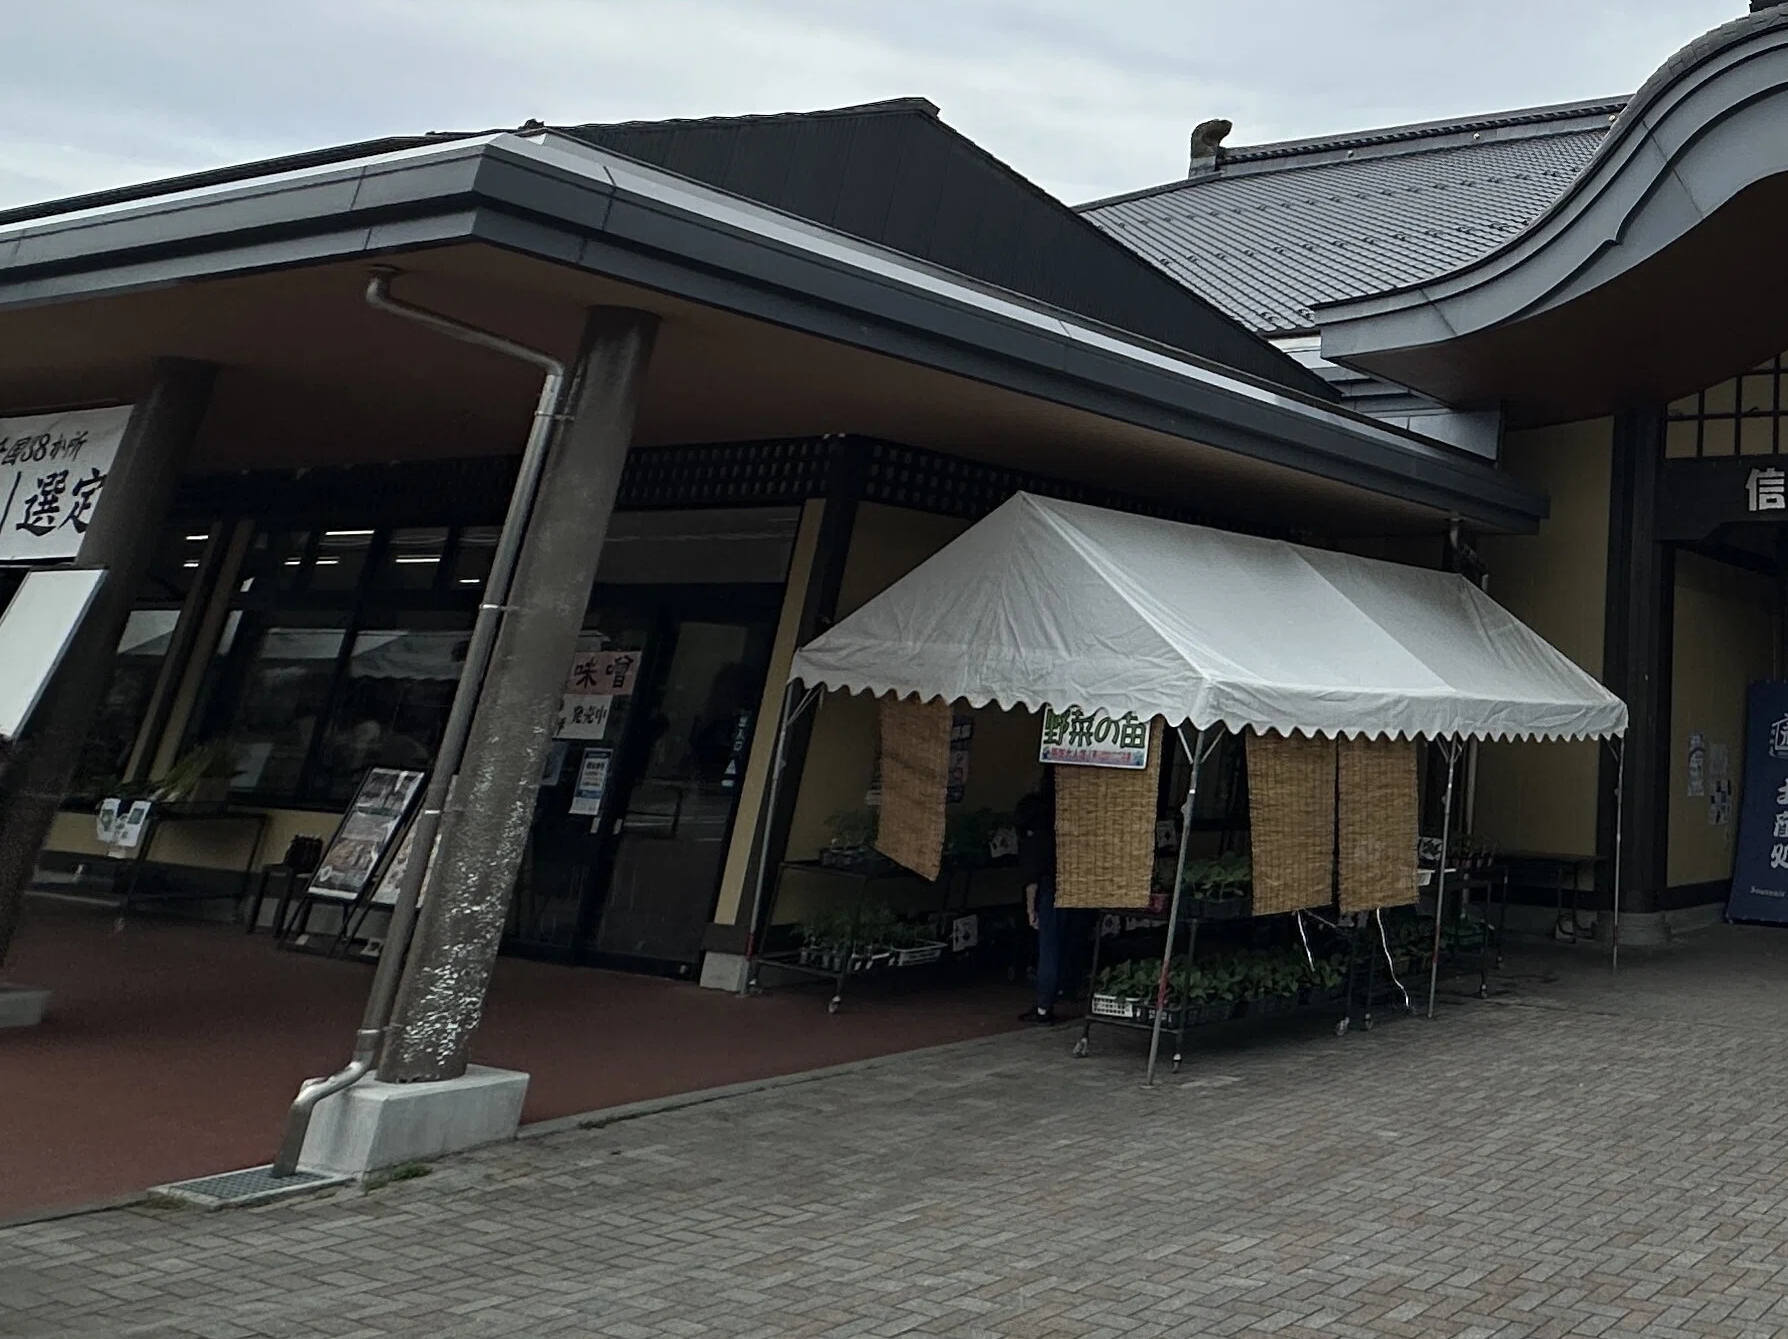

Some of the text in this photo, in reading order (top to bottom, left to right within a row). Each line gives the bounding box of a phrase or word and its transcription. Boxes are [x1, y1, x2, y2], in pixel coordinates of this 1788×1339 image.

[0, 467, 107, 536] 選定
[574, 655, 634, 689] 味噌
[1043, 708, 1146, 749] 野菜の苗
